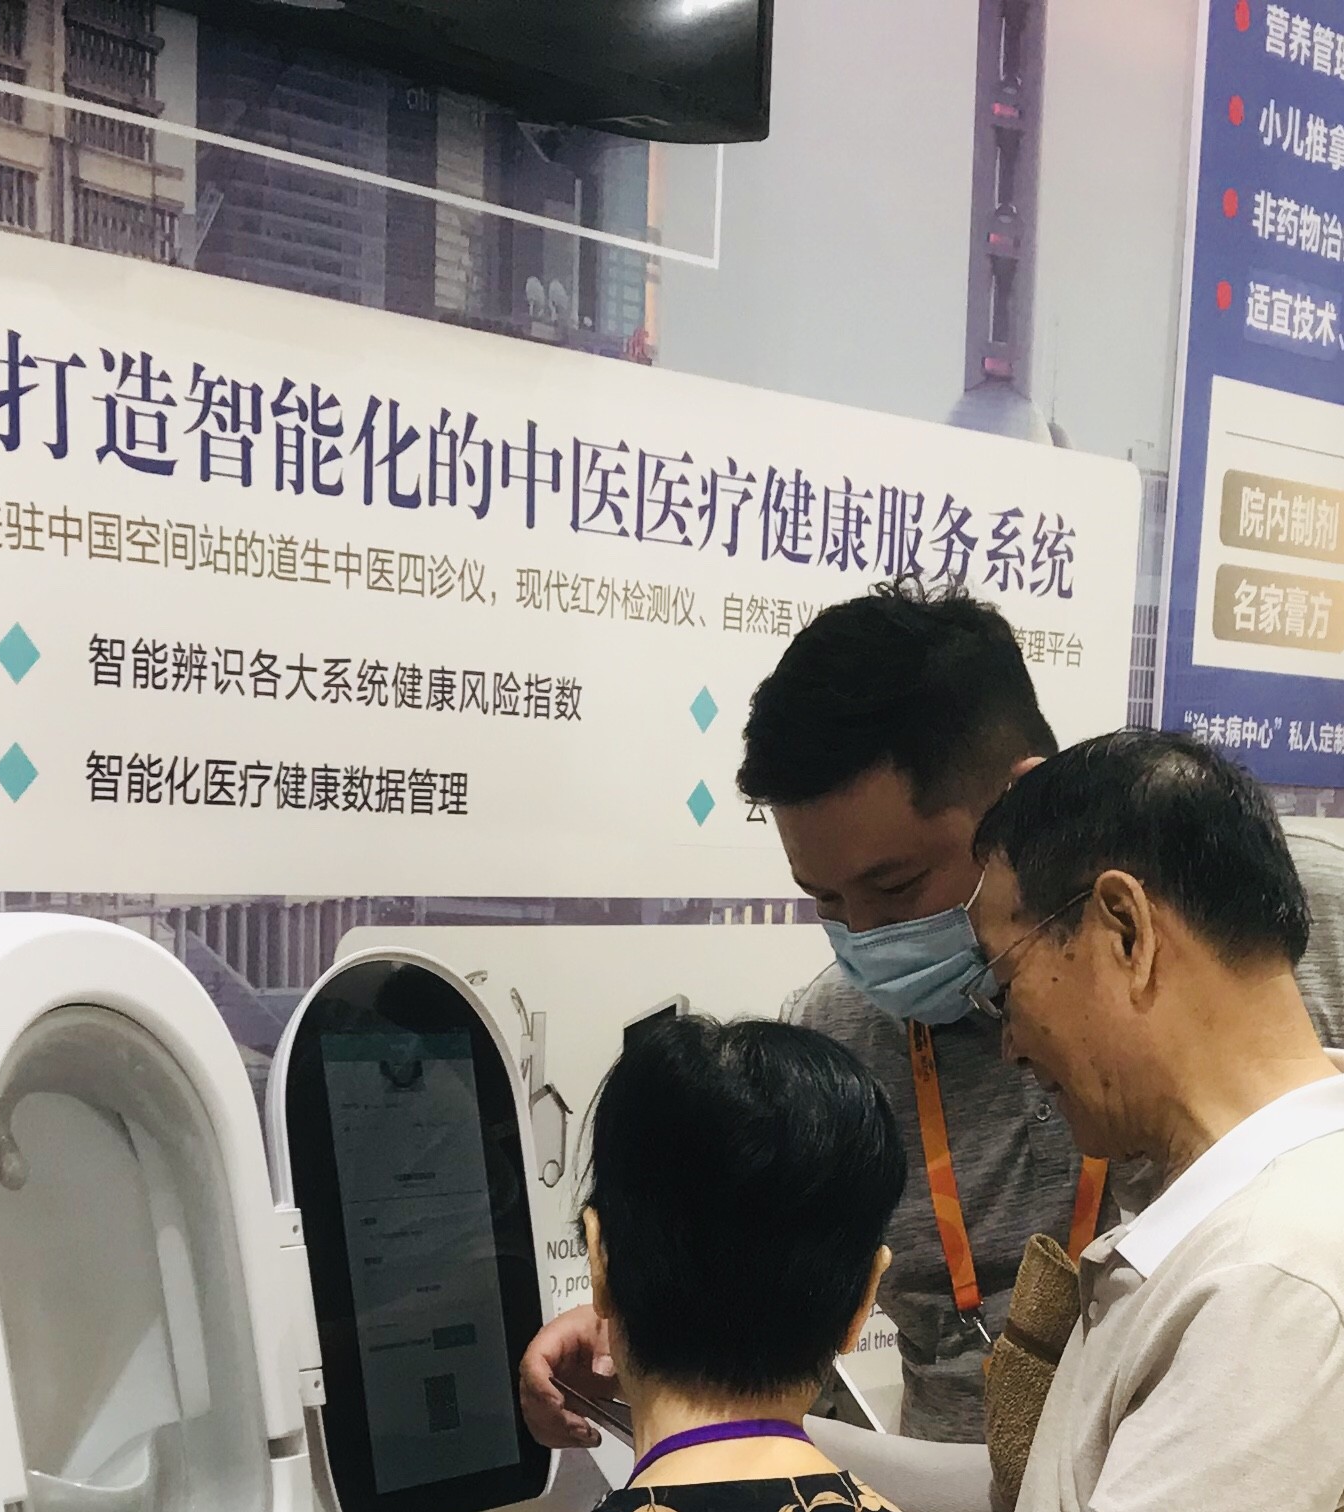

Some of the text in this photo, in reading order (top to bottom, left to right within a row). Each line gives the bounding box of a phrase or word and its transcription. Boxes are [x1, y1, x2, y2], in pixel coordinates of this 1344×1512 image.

[1239, 486, 1339, 552] 院内制剂
[1233, 578, 1332, 641] 名家膏方
[87, 635, 583, 722] 智能辨识各大系统健康风险指数
[85, 750, 470, 818] 智能化医疗健康数据管理
